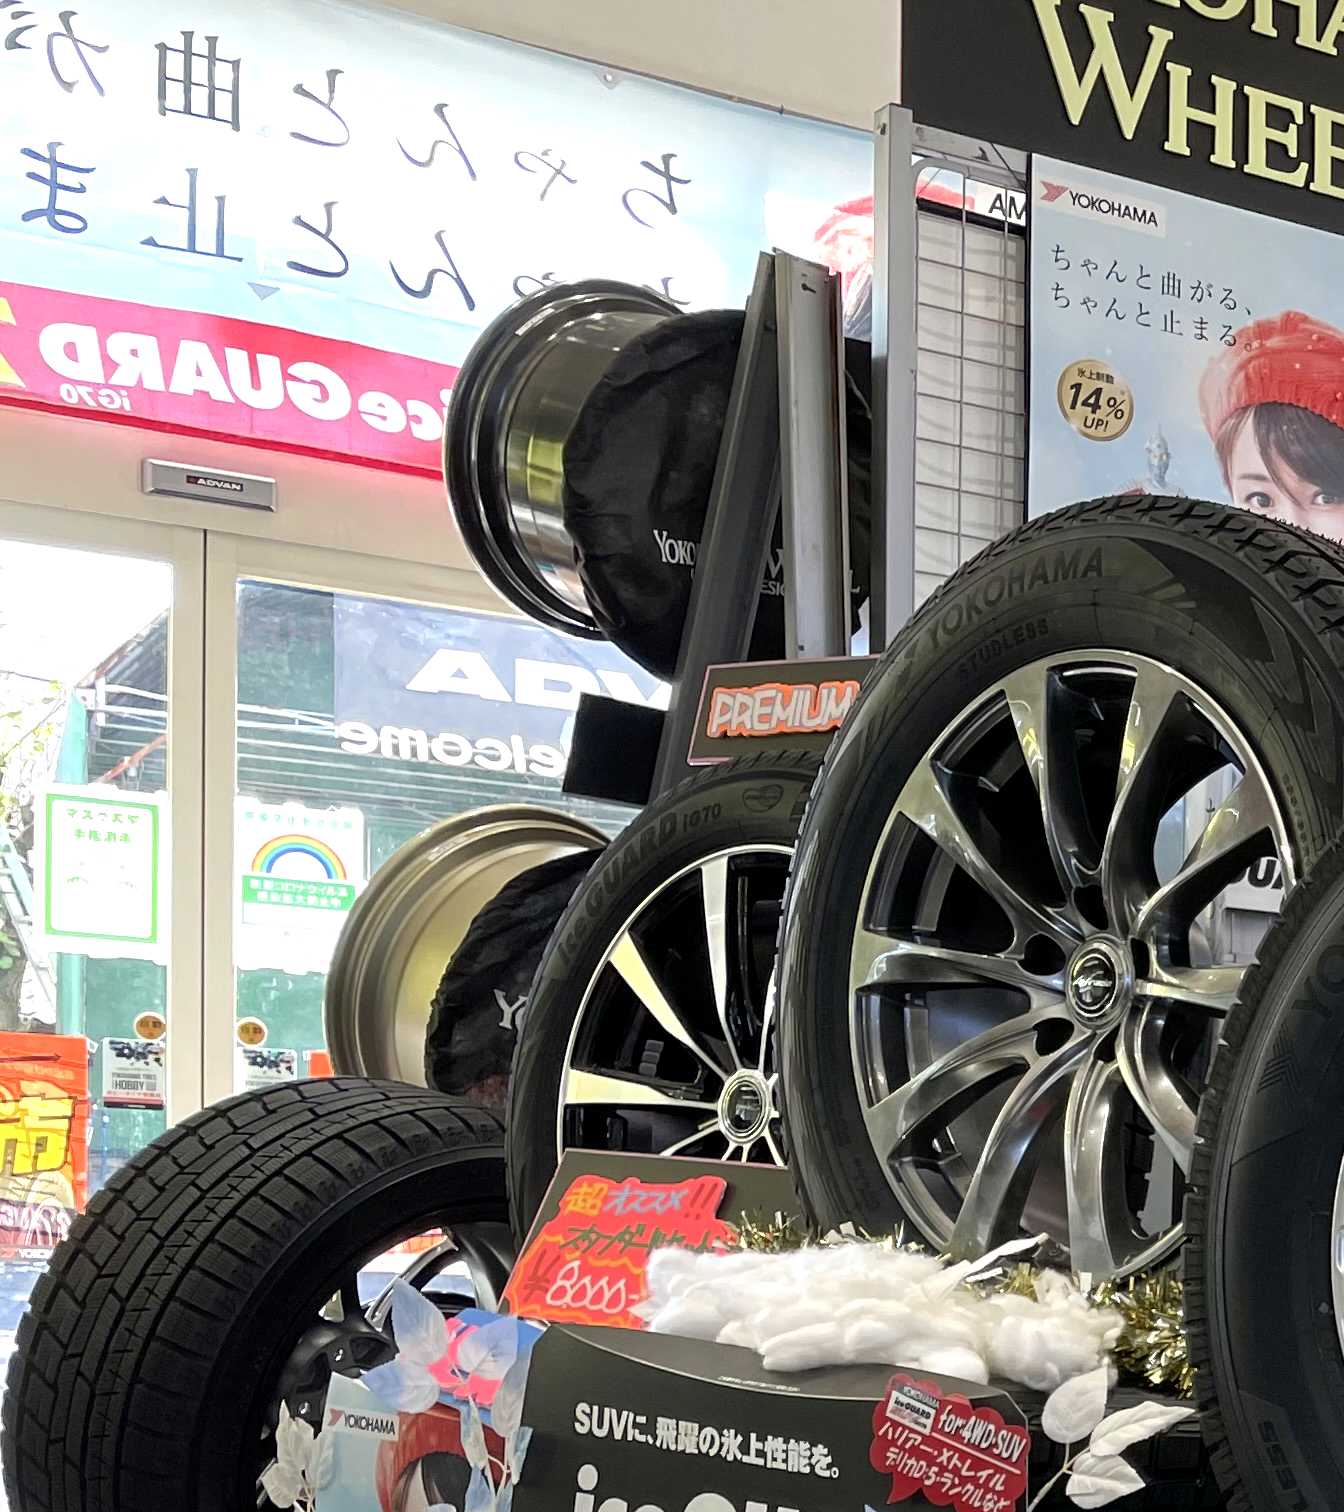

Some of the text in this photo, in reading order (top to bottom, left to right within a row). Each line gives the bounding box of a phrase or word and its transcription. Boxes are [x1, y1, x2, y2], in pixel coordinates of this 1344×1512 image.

[1068, 189, 1159, 227] YOKOHAMA
[1050, 243, 1256, 316] ちゃんと曲がる、
[1050, 282, 1257, 353] ちゃんと止まる。
[1066, 379, 1125, 421] 14%
[1083, 414, 1110, 432] UP!
[928, 547, 1103, 651] YOKOHAMA
[958, 619, 1050, 675] STUDLESS
[712, 687, 855, 733] PREMIUM
[343, 1413, 395, 1436] YOKOHAMA
